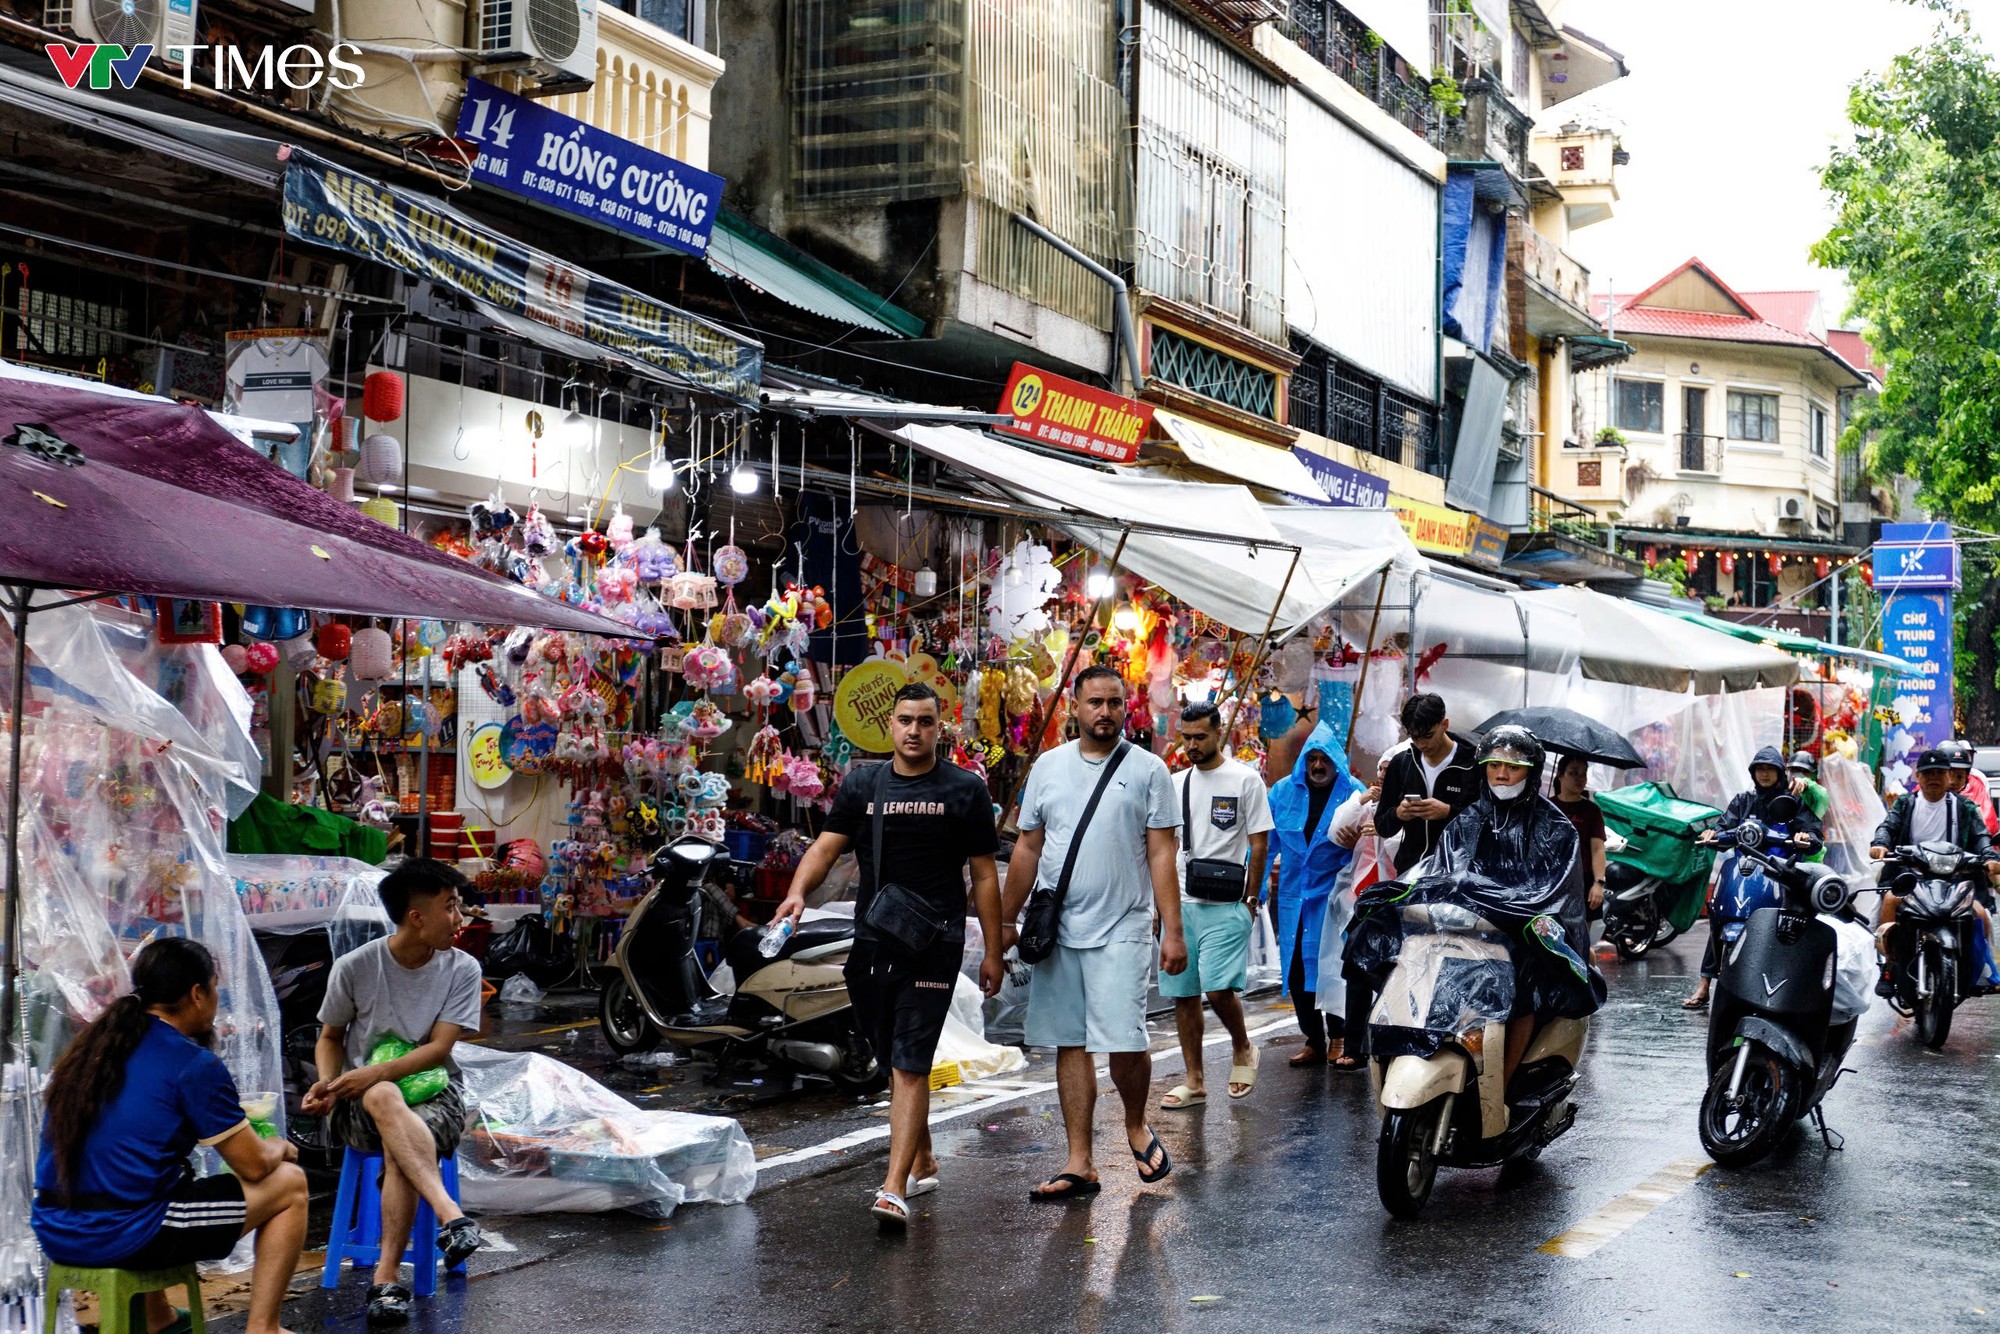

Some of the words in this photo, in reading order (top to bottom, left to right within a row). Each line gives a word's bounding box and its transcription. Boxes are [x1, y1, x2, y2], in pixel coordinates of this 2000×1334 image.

[464, 98, 517, 149] 14
[488, 158, 509, 177] MÃ
[536, 124, 617, 190] HỒNG
[620, 165, 708, 225] CƯỜNG
[324, 169, 397, 229] NGA
[537, 176, 556, 193] 038
[555, 182, 573, 199] 671
[574, 189, 594, 208] 1958
[600, 198, 616, 215] 038
[616, 203, 632, 219] 671
[314, 213, 348, 244] 098
[457, 266, 484, 295] 666
[620, 292, 663, 334] THU
[1015, 382, 1041, 409] 12A
[1040, 389, 1096, 431] THANH
[1093, 403, 1144, 445] THẮNG
[1316, 467, 1342, 498] HÀNG
[1342, 473, 1357, 503] LỄ
[1356, 483, 1373, 507] HỘI
[1894, 630, 1935, 641] TRUNG
[1902, 612, 1927, 626] CHỢ
[1902, 646, 1927, 657] THU
[848, 682, 897, 722] TRUNG
[442, 721, 454, 740] 14
[868, 708, 892, 740] TH
[866, 801, 944, 815] BLENCIAGA
[915, 981, 949, 989] BALENCIAGA
